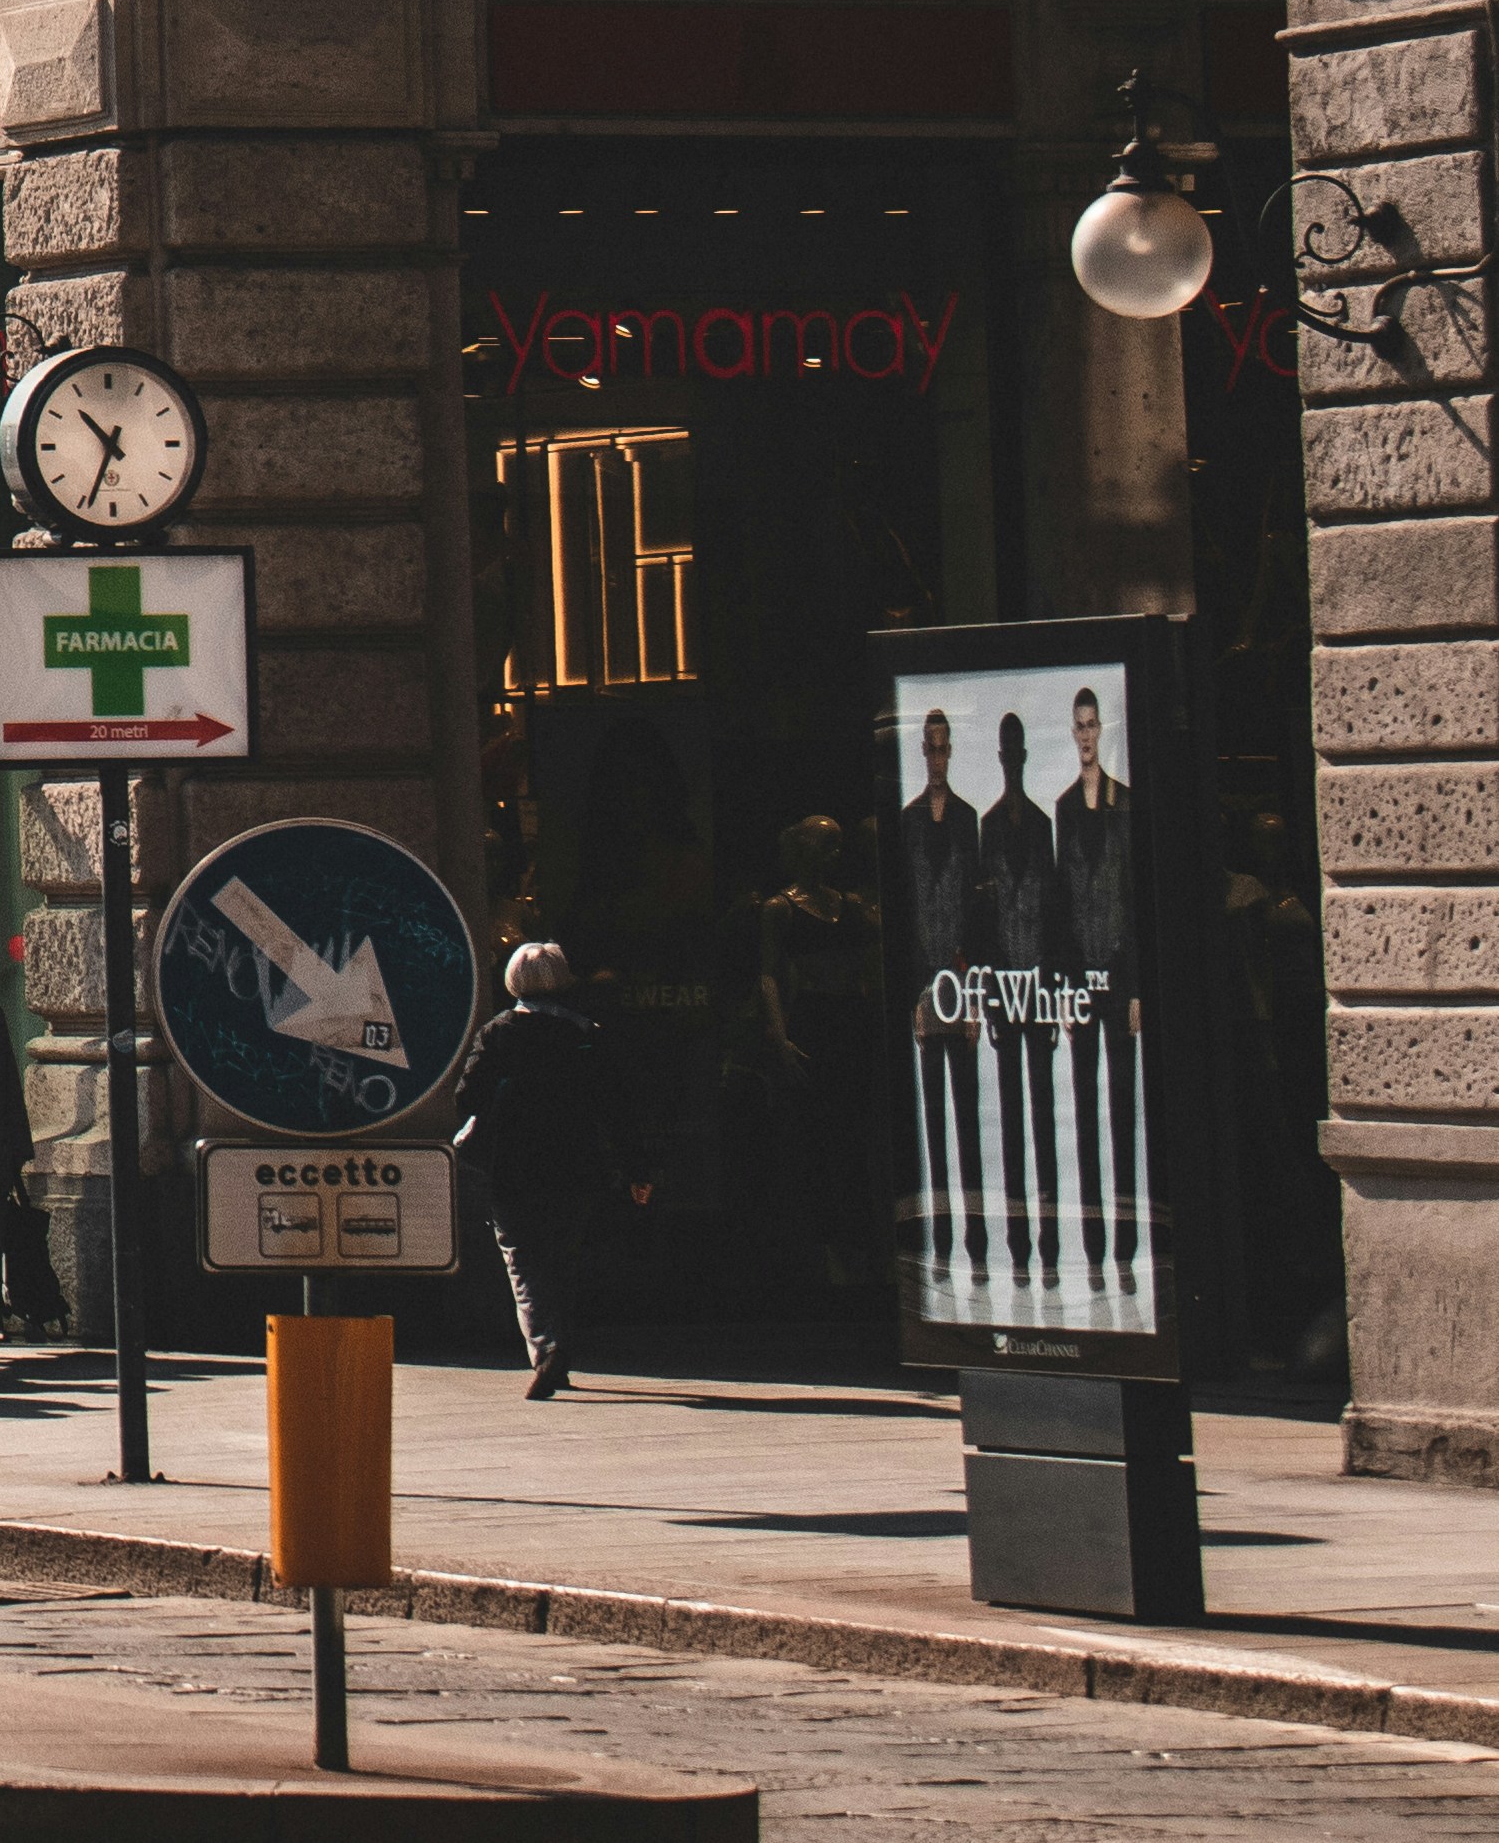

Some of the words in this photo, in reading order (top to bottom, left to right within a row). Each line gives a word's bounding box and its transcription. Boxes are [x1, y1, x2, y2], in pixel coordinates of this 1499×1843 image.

[487, 288, 960, 396] yamamay
[55, 631, 180, 653] FARMACIA
[89, 724, 107, 740] 20
[110, 723, 149, 740] metri
[365, 1024, 390, 1048] 03
[254, 1159, 403, 1187] eccetto
